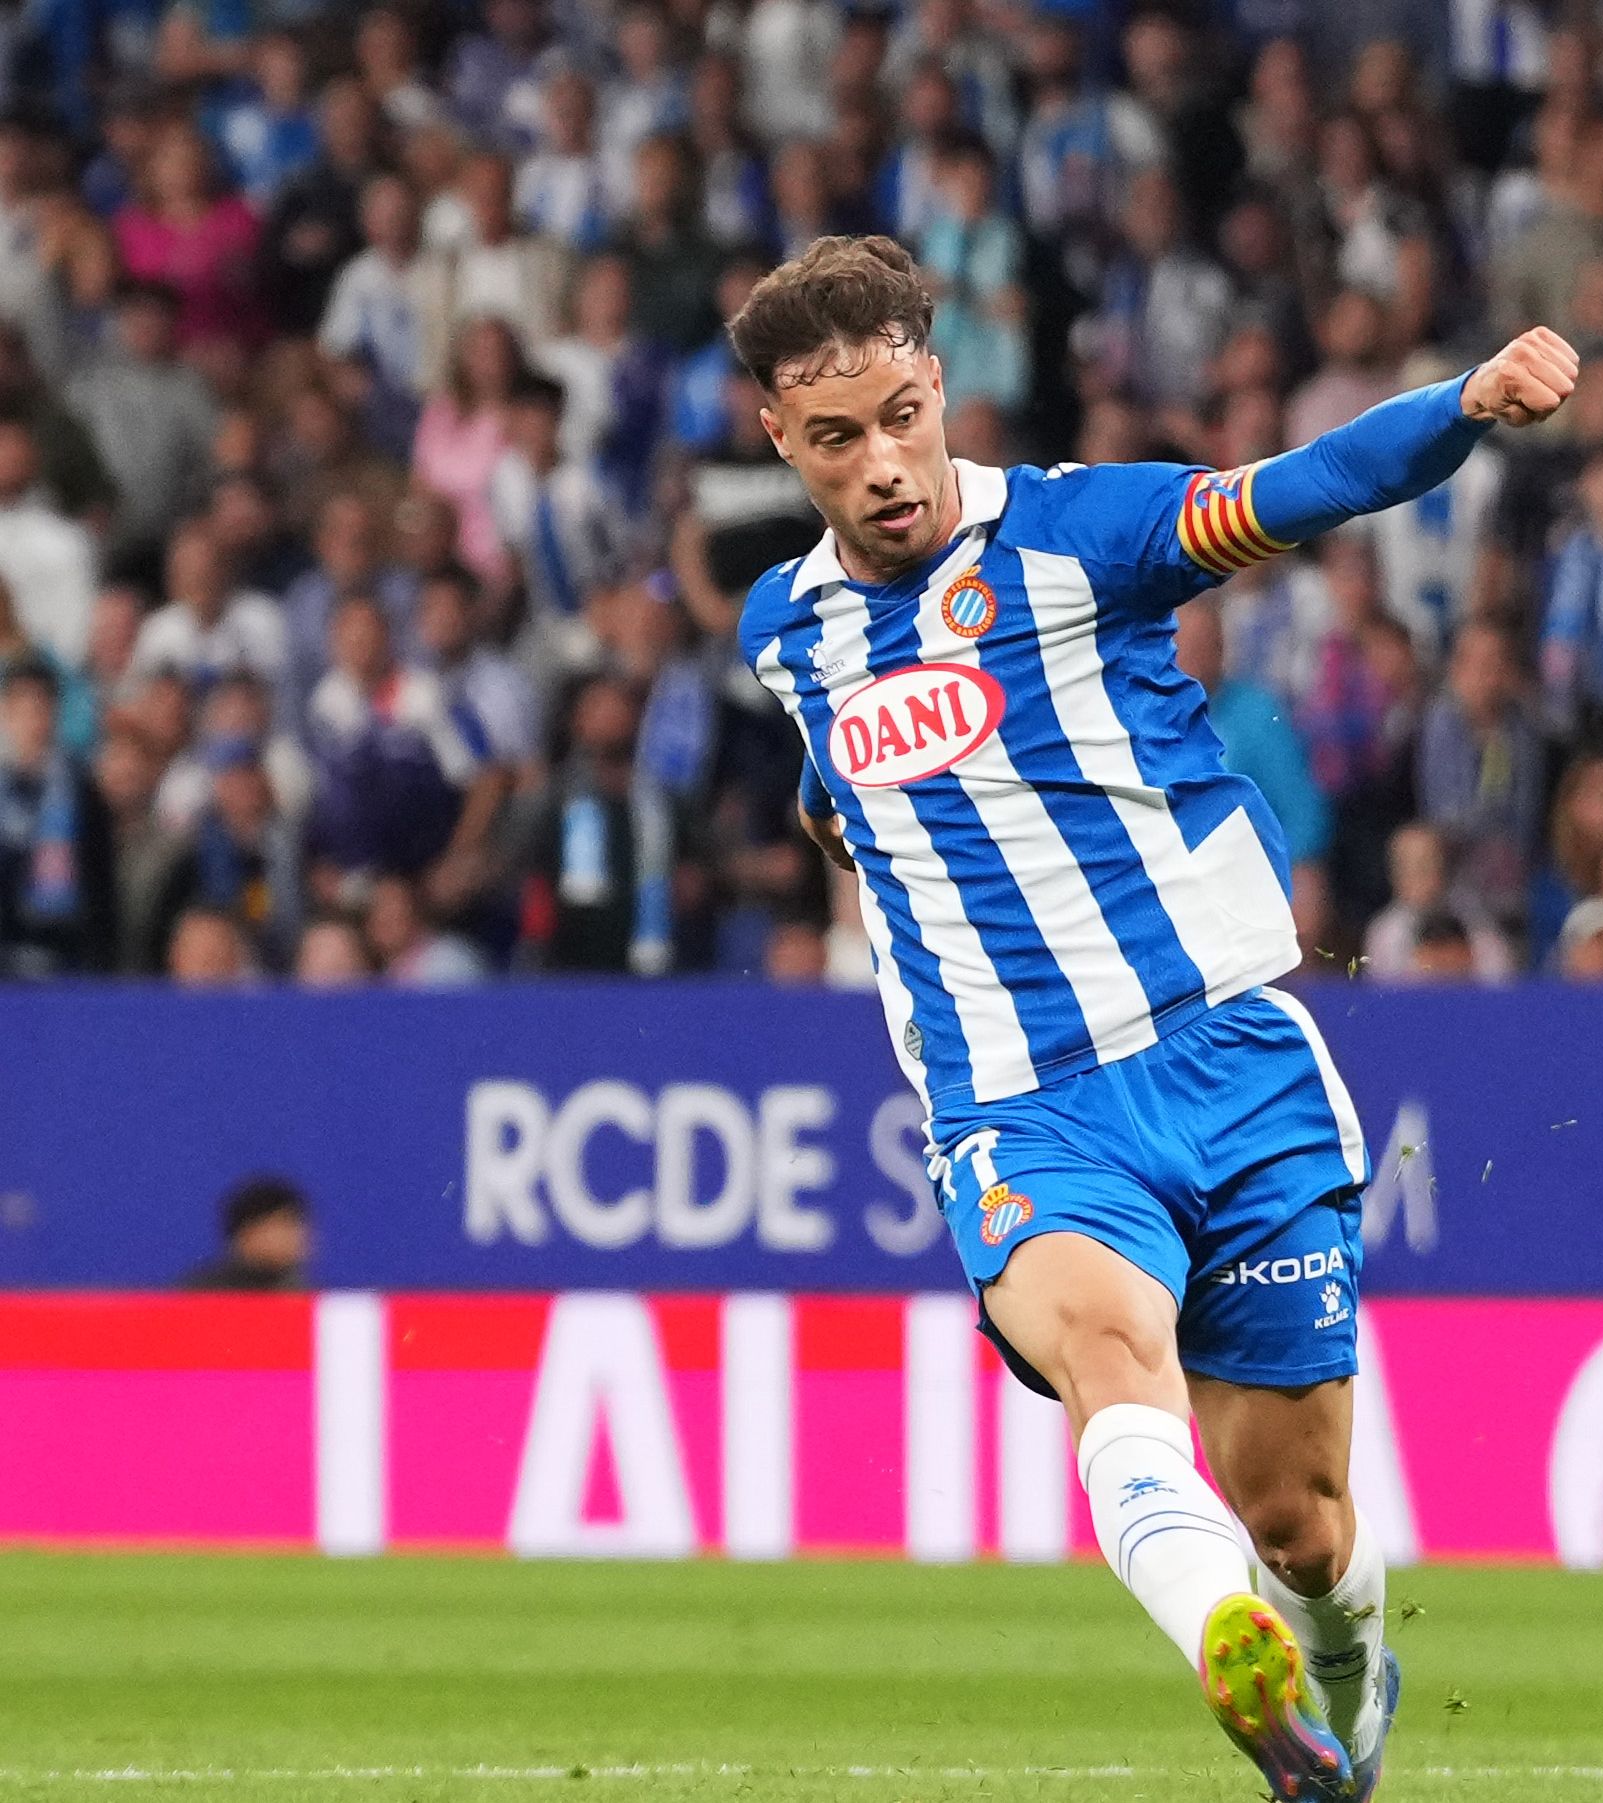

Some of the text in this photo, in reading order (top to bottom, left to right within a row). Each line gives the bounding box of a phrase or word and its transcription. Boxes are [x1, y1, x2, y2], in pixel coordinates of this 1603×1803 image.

[840, 681, 971, 774] DANI
[465, 1080, 835, 1252] RCDE
[1314, 1310, 1350, 1330] KELME
